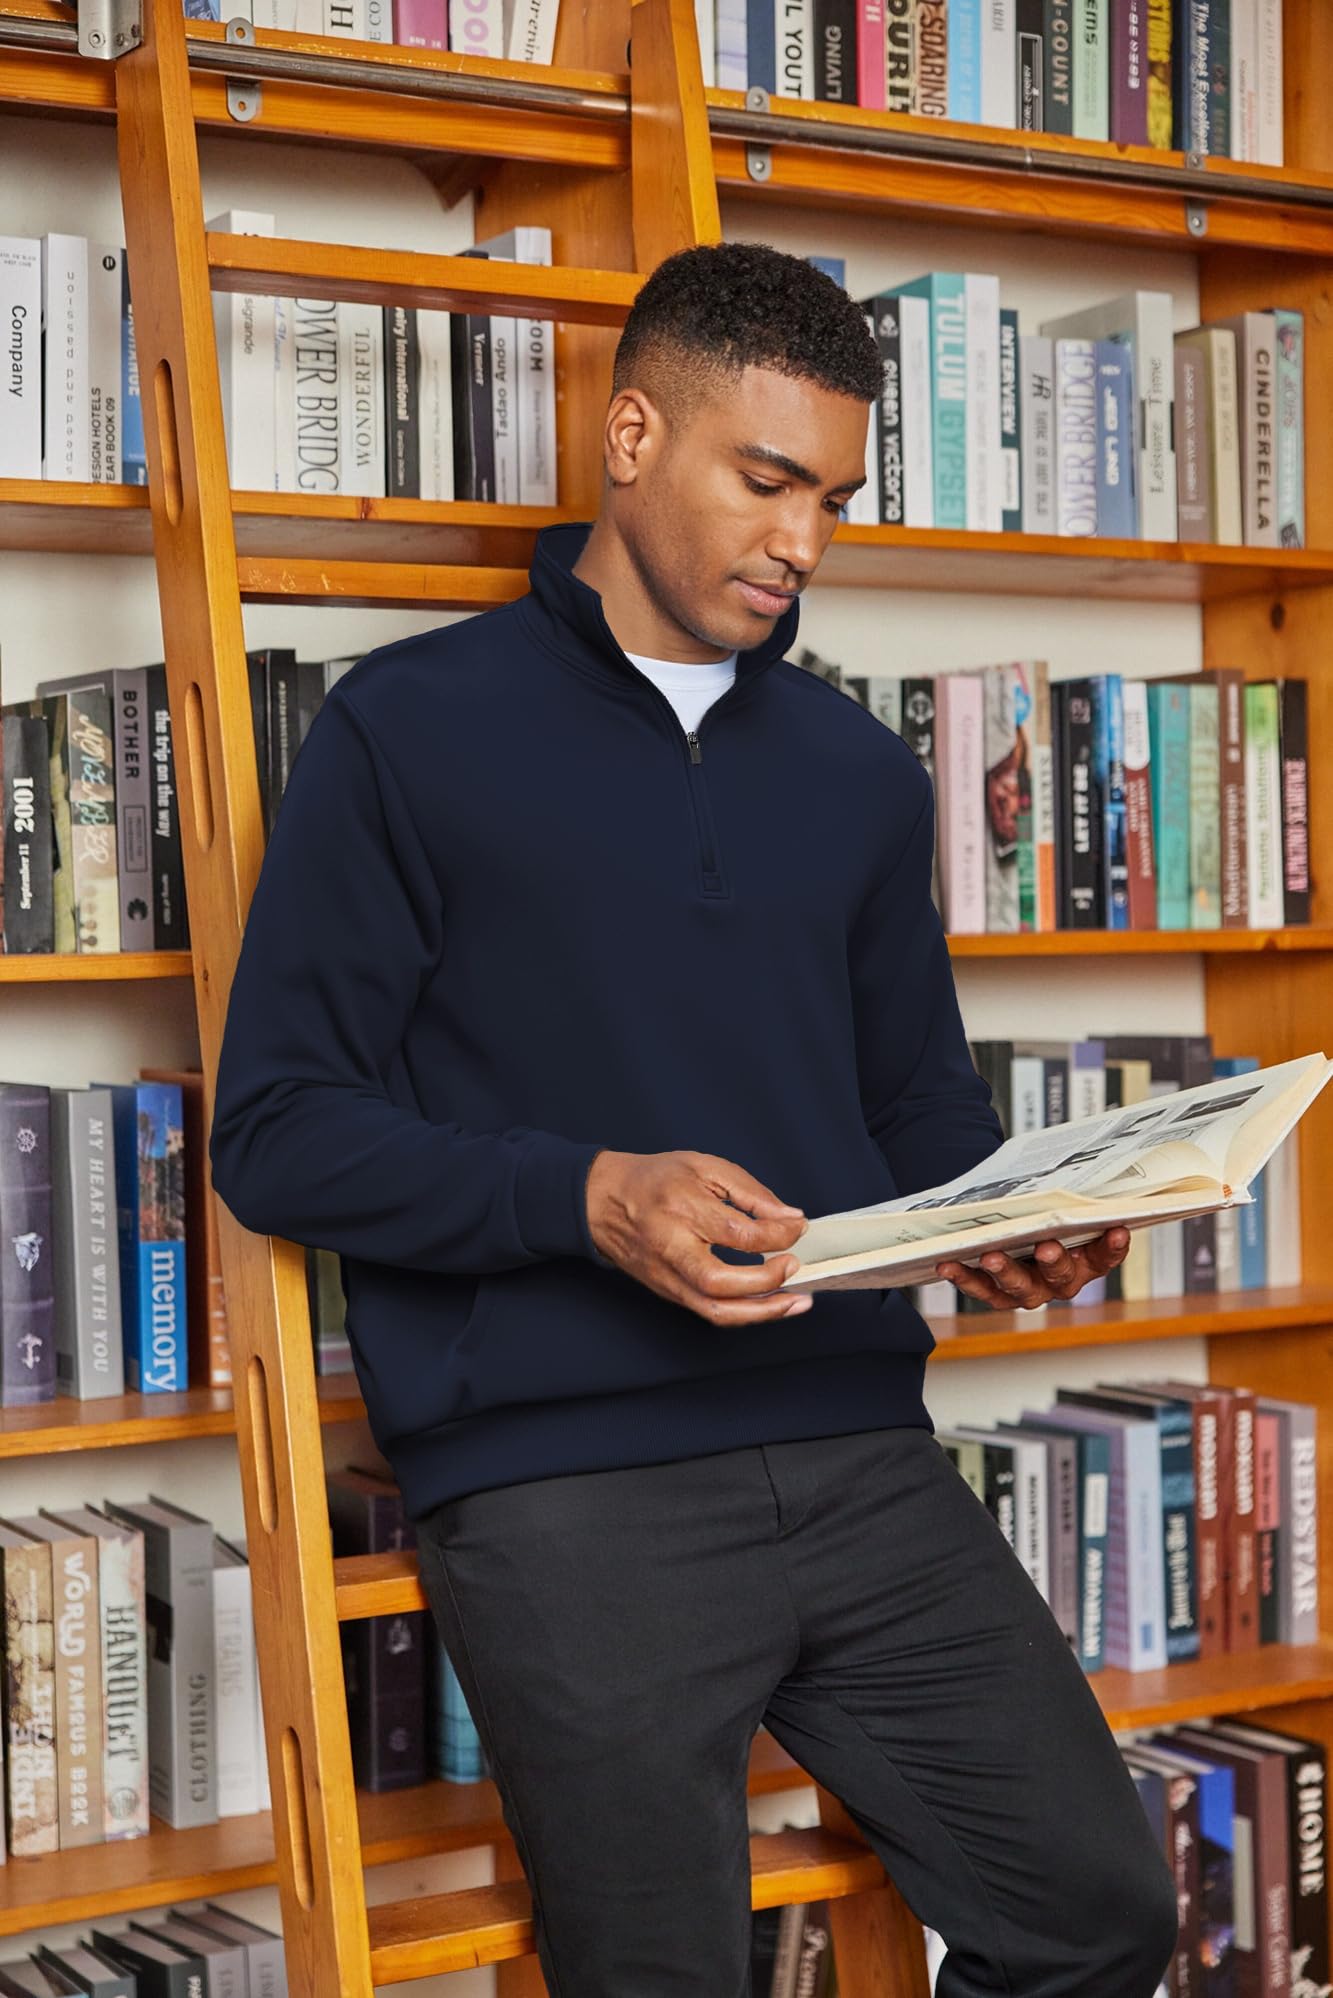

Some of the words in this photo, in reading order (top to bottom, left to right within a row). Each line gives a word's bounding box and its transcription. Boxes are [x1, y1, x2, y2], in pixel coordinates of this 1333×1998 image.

[1198, 3, 1210, 33] The
[826, 25, 843, 99] LIVING
[919, 15, 946, 117] SOARING
[1198, 37, 1210, 76] Most
[10, 306, 28, 397] Company
[493, 338, 507, 383] Ando
[937, 292, 965, 400] TULUM
[355, 327, 372, 468] WONDERFUL
[396, 339, 409, 421] International
[1000, 325, 1015, 434] INTERVIEW
[91, 387, 101, 437] HOTELS
[105, 415, 115, 452] BOOK
[495, 388, 509, 441] Tadao
[1256, 348, 1272, 531] CINDERELLA
[123, 690, 140, 779] BOTHER
[153, 736, 171, 762] trip
[155, 710, 171, 733] the
[157, 764, 169, 782] on
[157, 784, 174, 807] the
[13, 776, 34, 833] 2001
[155, 809, 171, 838] way
[19, 856, 32, 910] September
[87, 1118, 104, 1150] MY
[89, 1158, 106, 1229] HEART
[91, 1236, 106, 1254] IS
[92, 1263, 107, 1320] WITH
[144, 1249, 177, 1392] memory
[94, 1329, 109, 1373] YOU
[1292, 1437, 1317, 1616] REDSTAR
[60, 1552, 91, 1658] WORLD
[189, 1672, 208, 1803] CLOTHING
